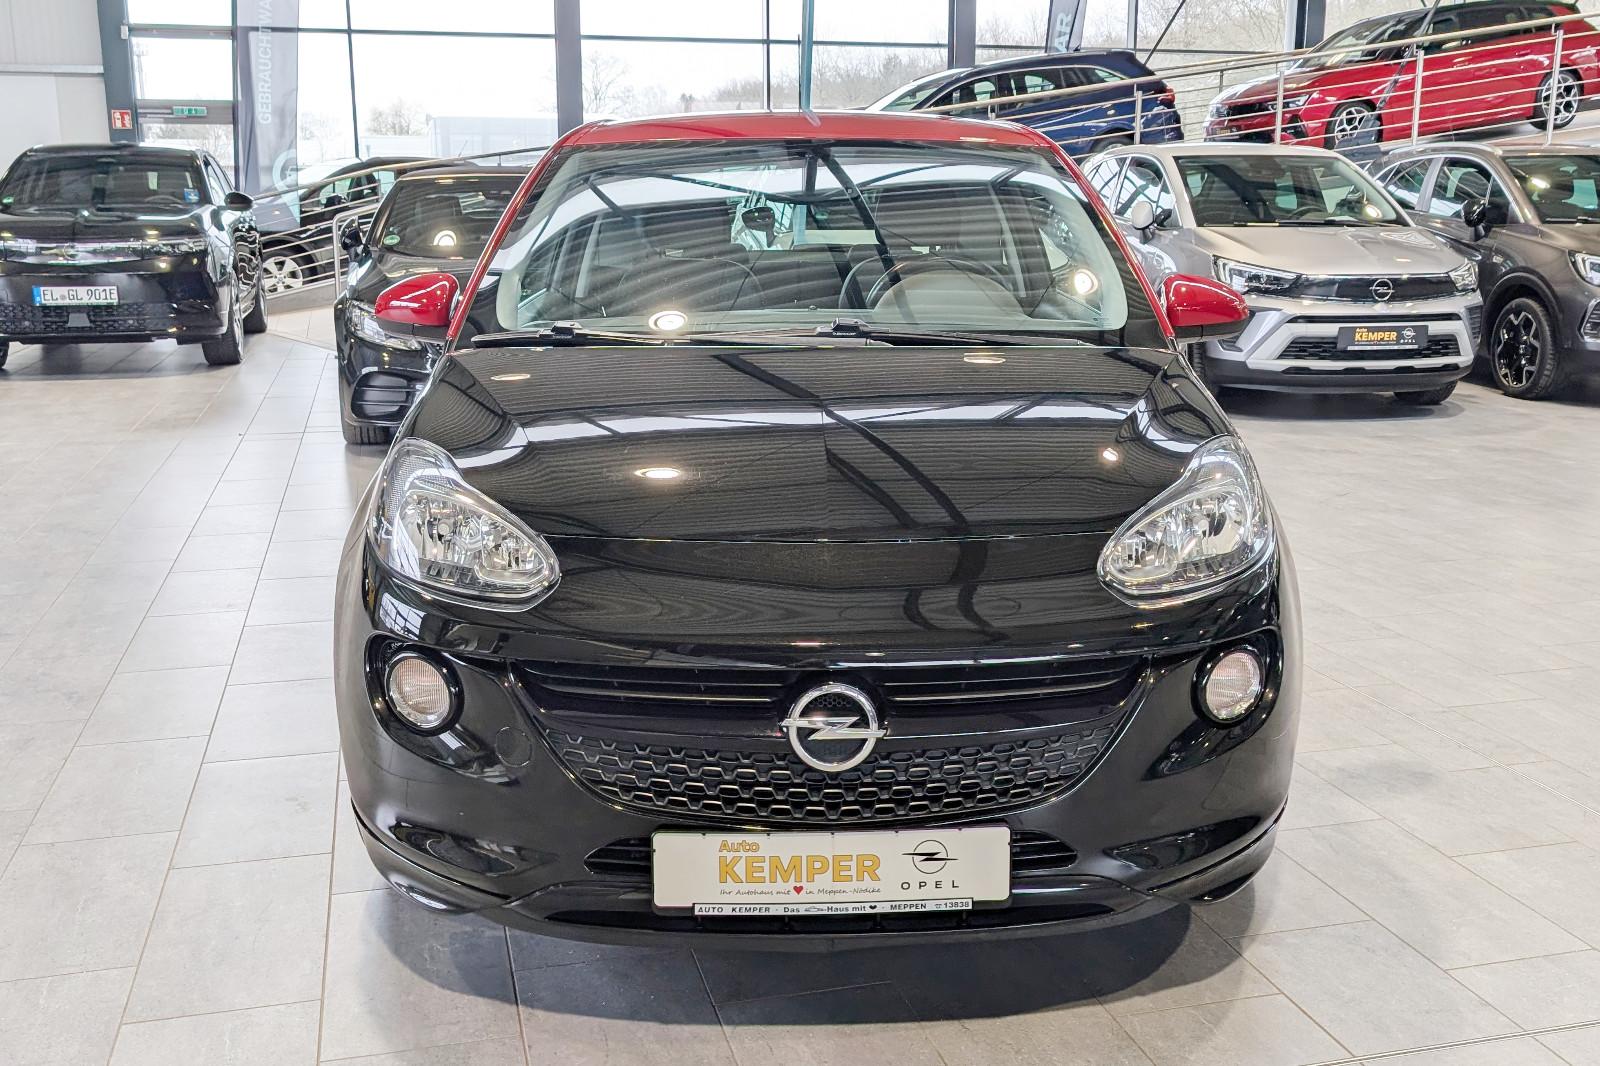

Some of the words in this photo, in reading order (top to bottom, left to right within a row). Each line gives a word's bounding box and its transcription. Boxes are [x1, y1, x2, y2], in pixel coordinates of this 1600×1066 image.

[258, 0, 272, 124] GEBRAUCHTWA
[42, 289, 58, 301] EL
[67, 288, 83, 301] GL
[86, 288, 117, 301] 901E
[1355, 332, 1397, 340] KEMPER
[718, 839, 760, 852] Auto
[719, 854, 880, 883] KEMPER
[900, 880, 960, 891] OPEL
[889, 903, 927, 911] MEPPEN
